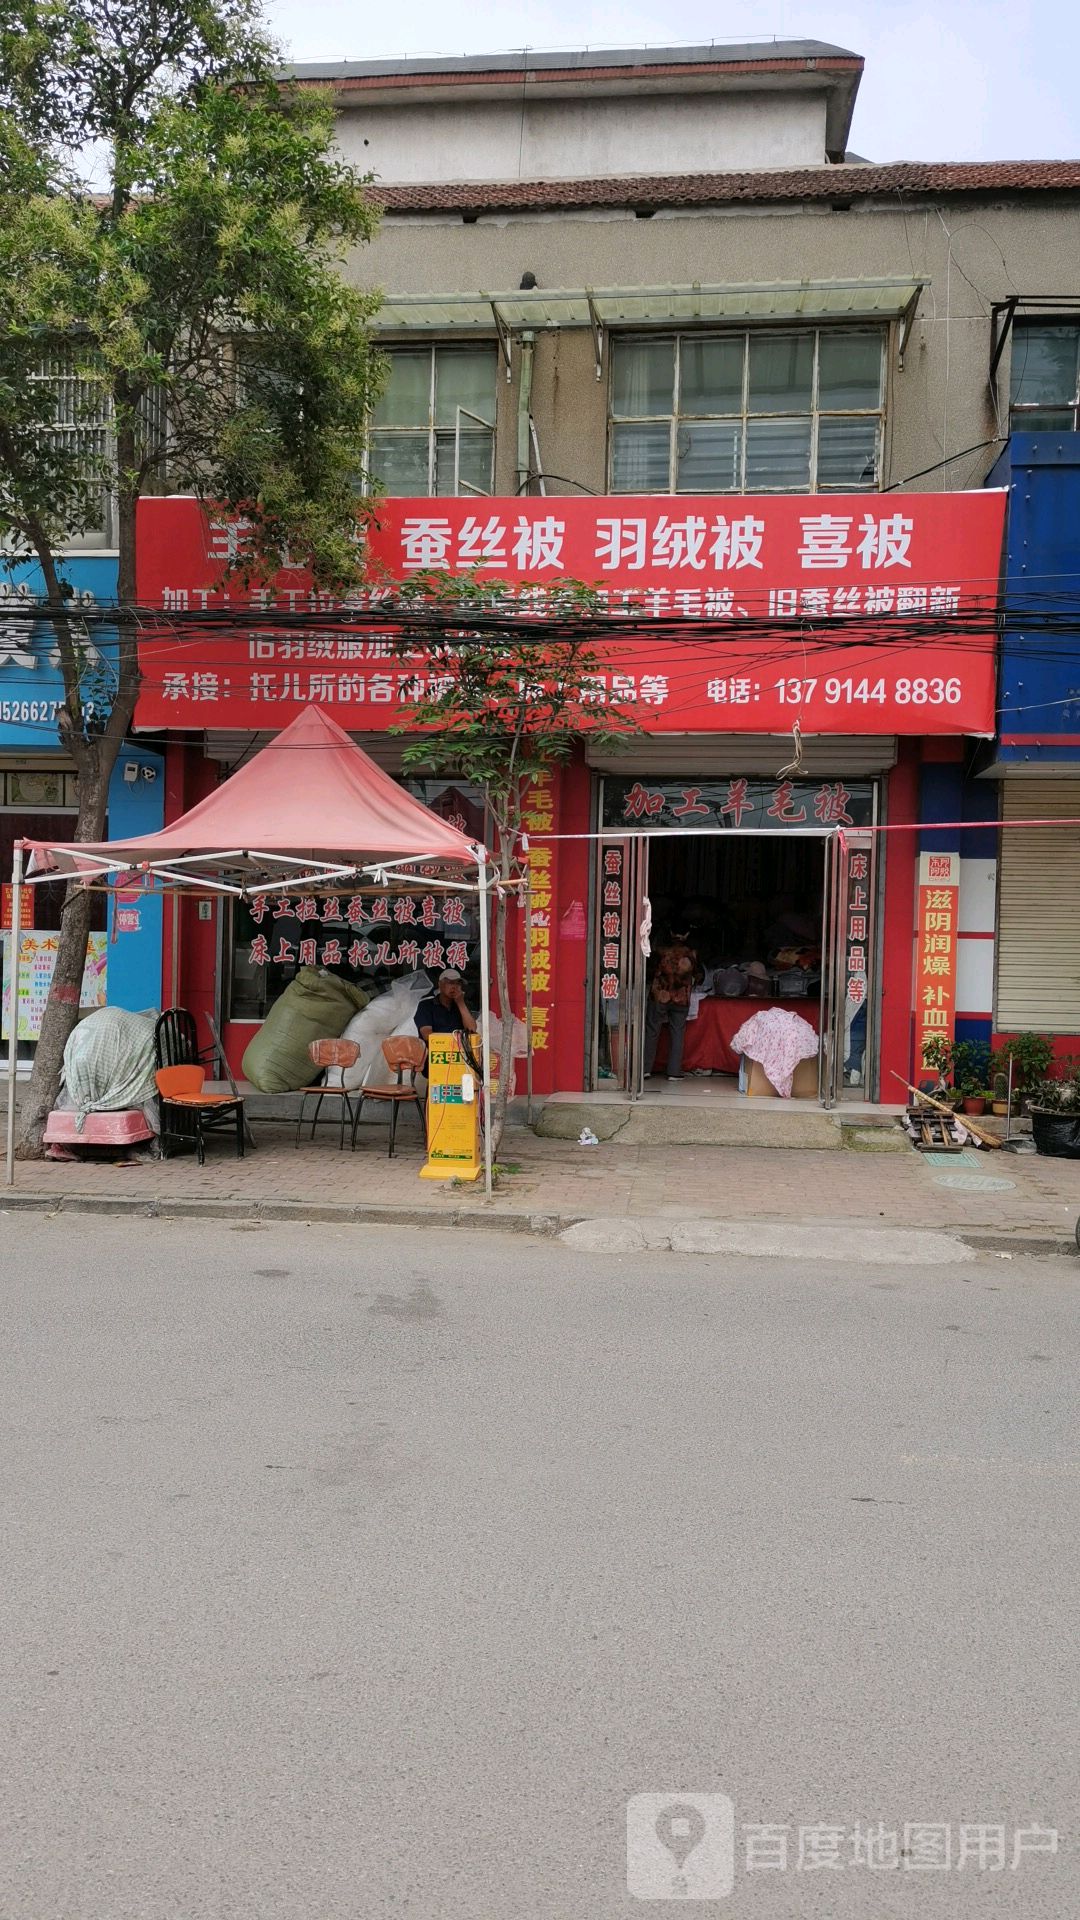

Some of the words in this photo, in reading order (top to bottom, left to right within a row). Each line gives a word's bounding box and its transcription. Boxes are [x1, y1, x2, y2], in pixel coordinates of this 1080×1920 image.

[400, 516, 566, 571] 蚕丝被
[594, 514, 766, 571] 羽绒被
[797, 513, 915, 569] 喜被
[825, 679, 887, 704] 9144
[894, 678, 962, 704] 8836
[623, 778, 854, 827] 加工羊毛被
[248, 895, 467, 928] 手工拉丝蚕丝被喜被
[602, 850, 622, 1000] 蚕丝被喜被
[847, 854, 868, 1004] 床上用品等
[924, 890, 953, 976] 滋阴润燥
